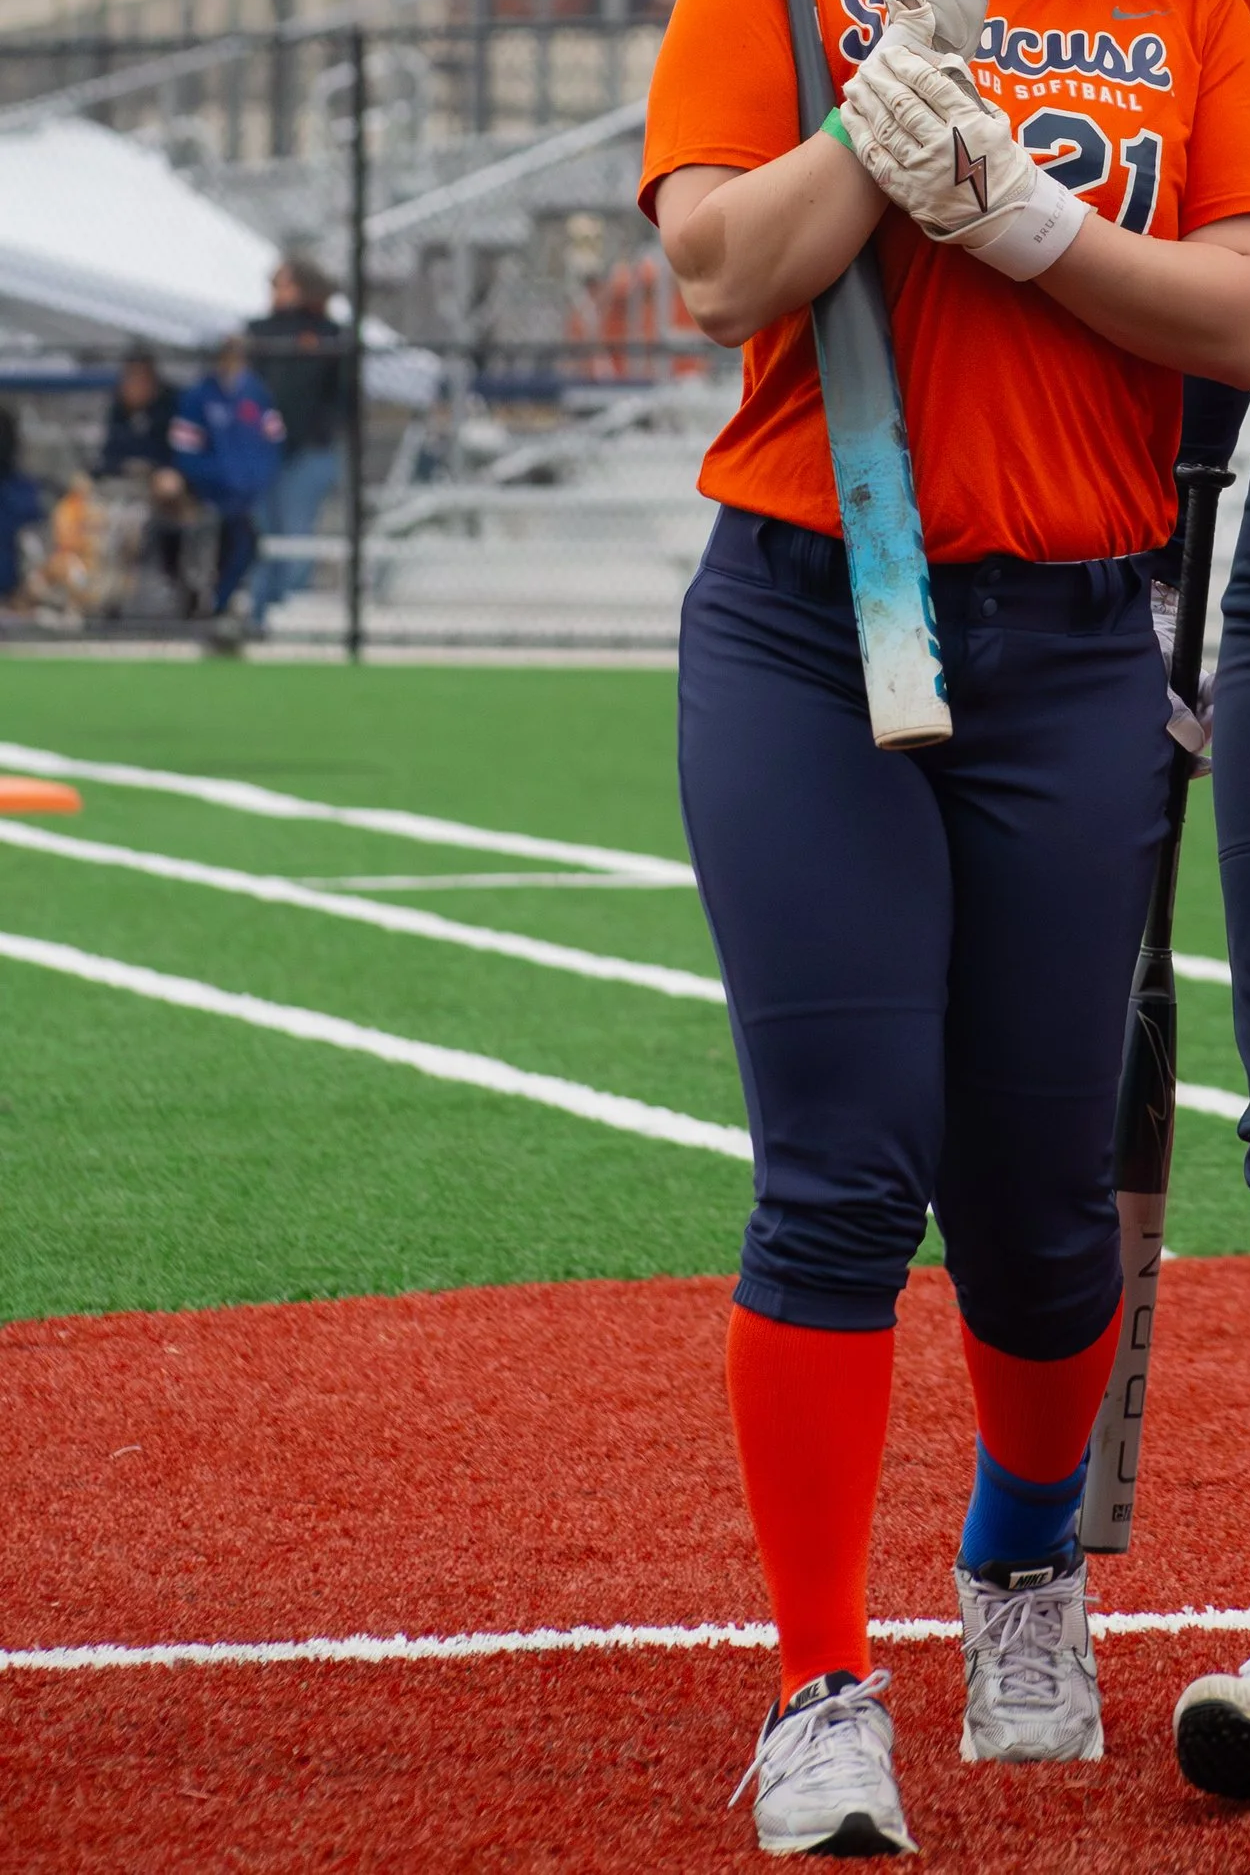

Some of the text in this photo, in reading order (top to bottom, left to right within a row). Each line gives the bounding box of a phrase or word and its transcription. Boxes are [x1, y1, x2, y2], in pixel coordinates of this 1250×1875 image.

[975, 68, 1144, 113] UB SOFTBALL
[1018, 106, 1163, 235] 21
[1012, 1571, 1049, 1590] NIKE
